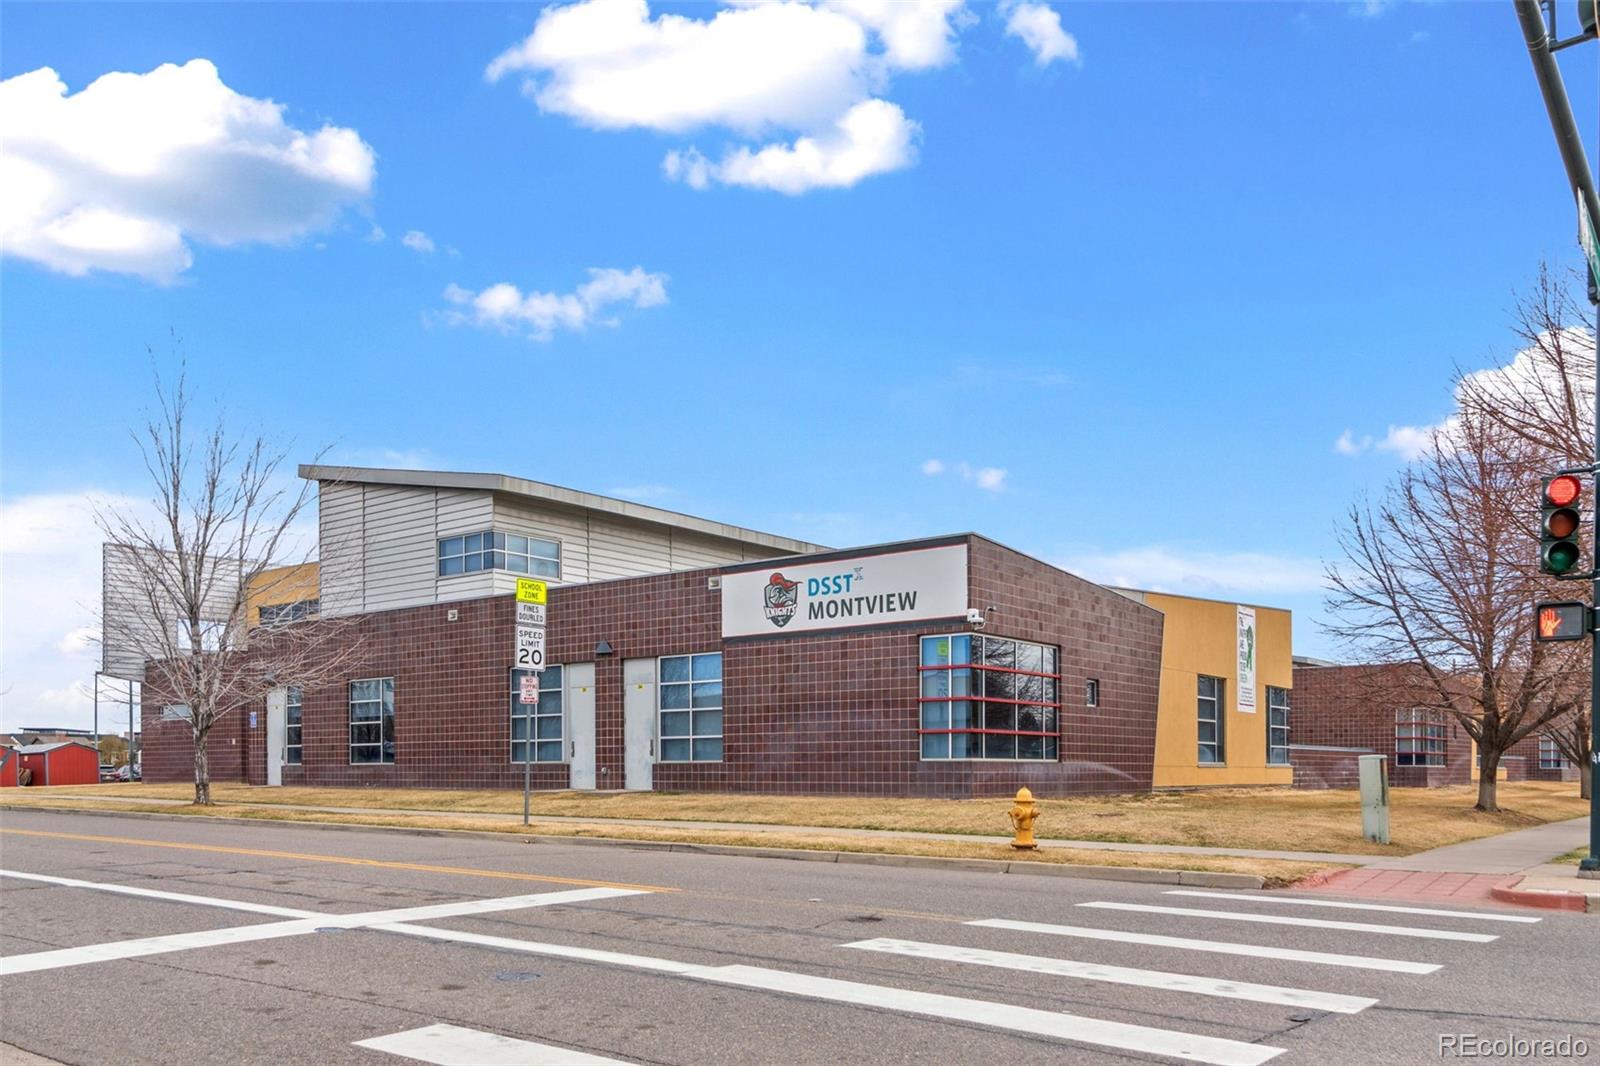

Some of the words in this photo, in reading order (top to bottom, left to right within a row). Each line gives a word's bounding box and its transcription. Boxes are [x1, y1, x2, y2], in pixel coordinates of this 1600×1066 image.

[520, 582, 542, 591] SCHOOL
[808, 574, 853, 596] DSST
[524, 591, 539, 600] ZONE
[524, 604, 539, 613] FINES
[808, 591, 917, 620] MONTVIEW
[766, 604, 797, 619] KNIGHTS
[518, 612, 543, 622] DOUBLED
[519, 630, 543, 640] SPEED
[521, 640, 540, 648] LIMIT
[519, 648, 542, 665] 20
